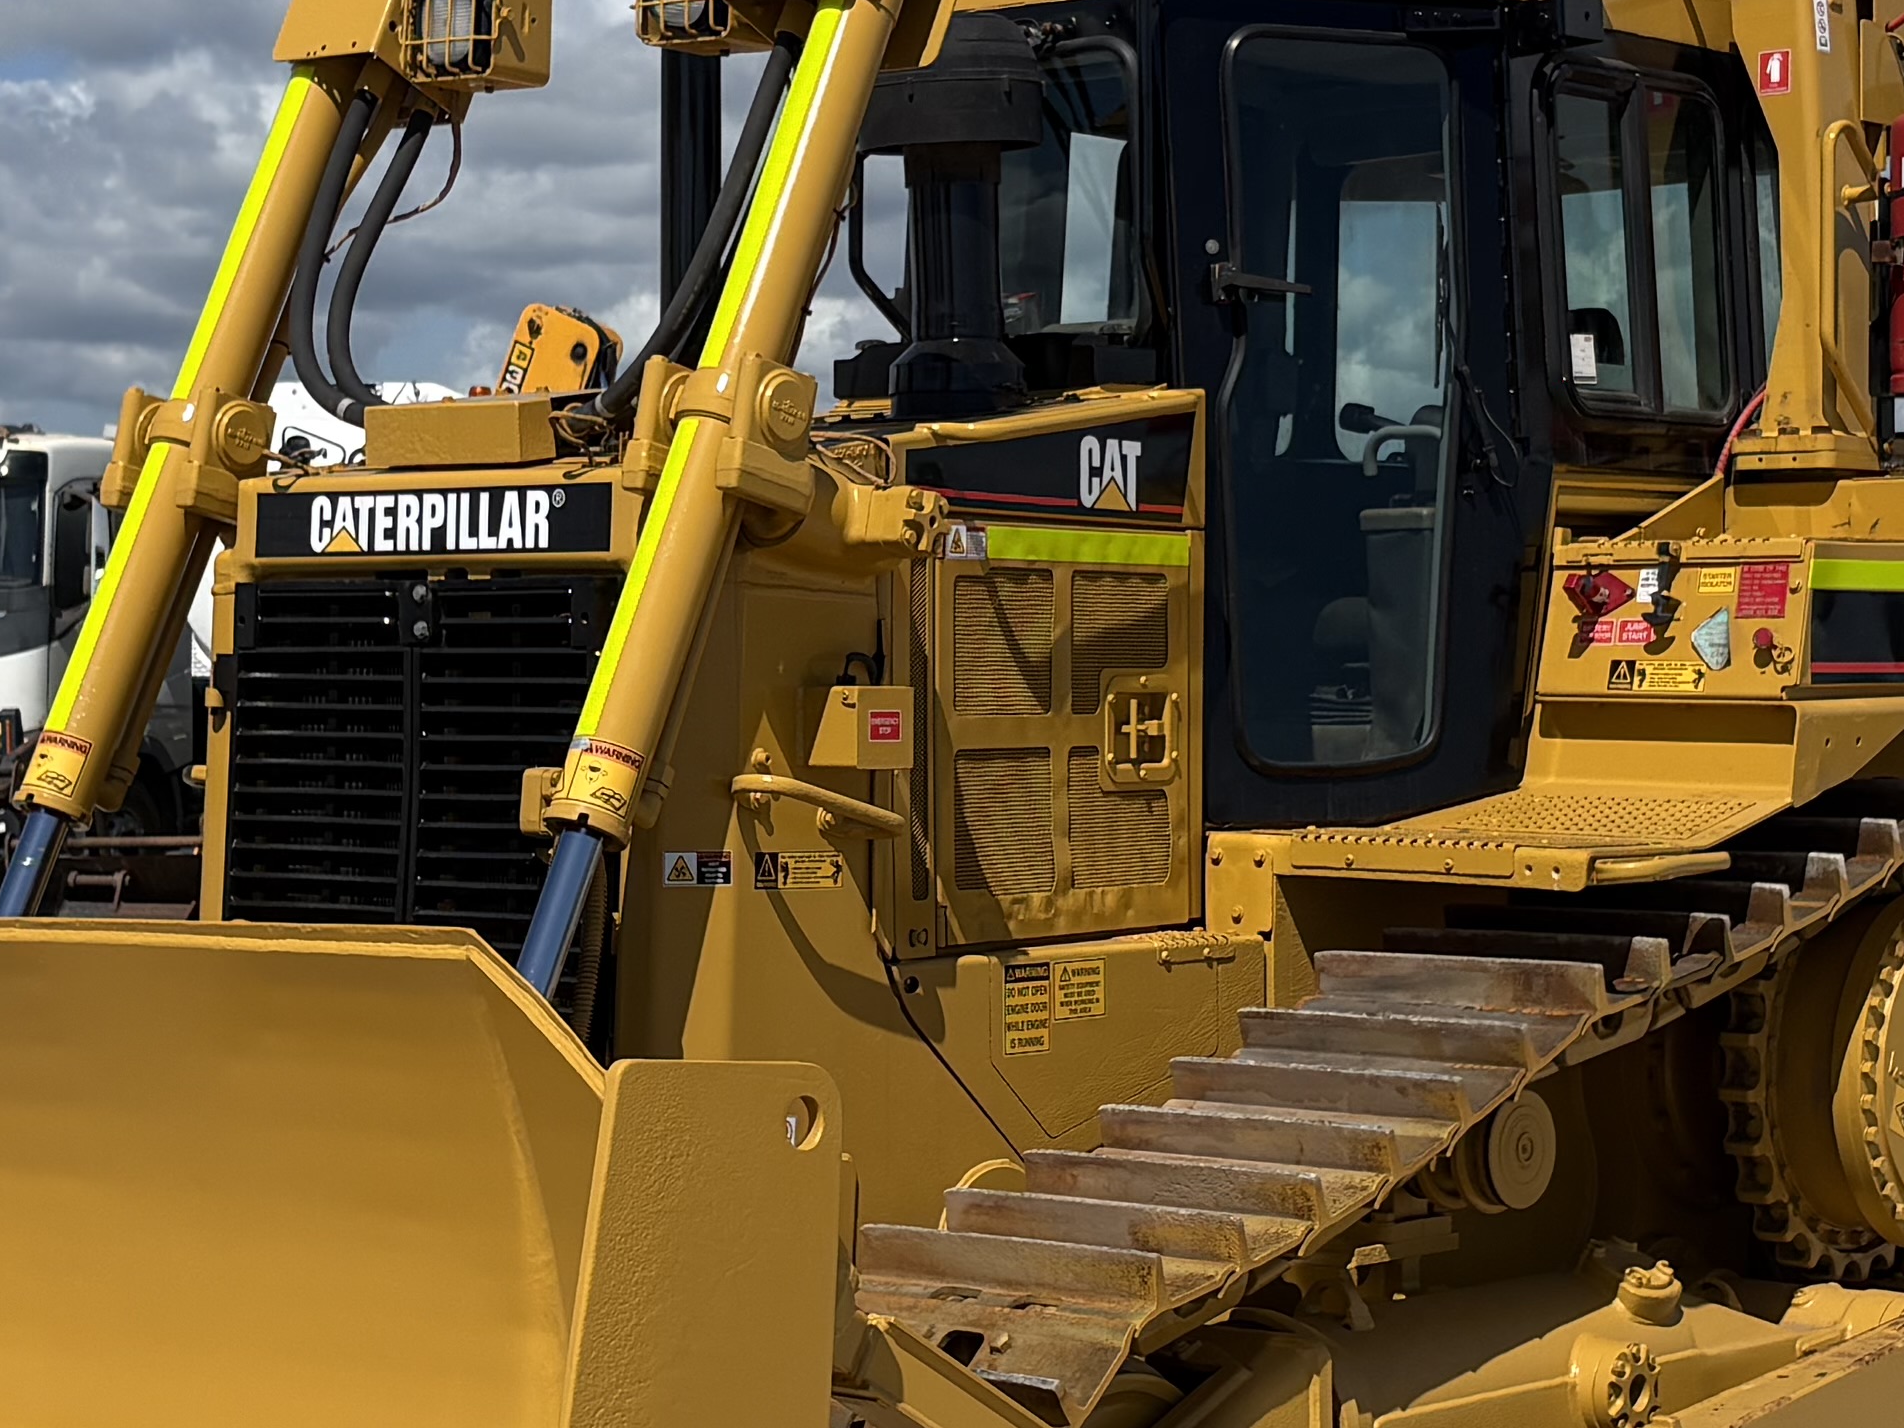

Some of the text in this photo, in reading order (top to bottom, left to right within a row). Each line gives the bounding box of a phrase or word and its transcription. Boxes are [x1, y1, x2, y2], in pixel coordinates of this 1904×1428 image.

[1079, 435, 1141, 512] CAT
[310, 489, 550, 553] CATERPILLAR
[1622, 631, 1648, 641] START
[595, 744, 641, 770] WARNING
[1014, 966, 1049, 978] WARNING
[1017, 986, 1030, 997] NOT
